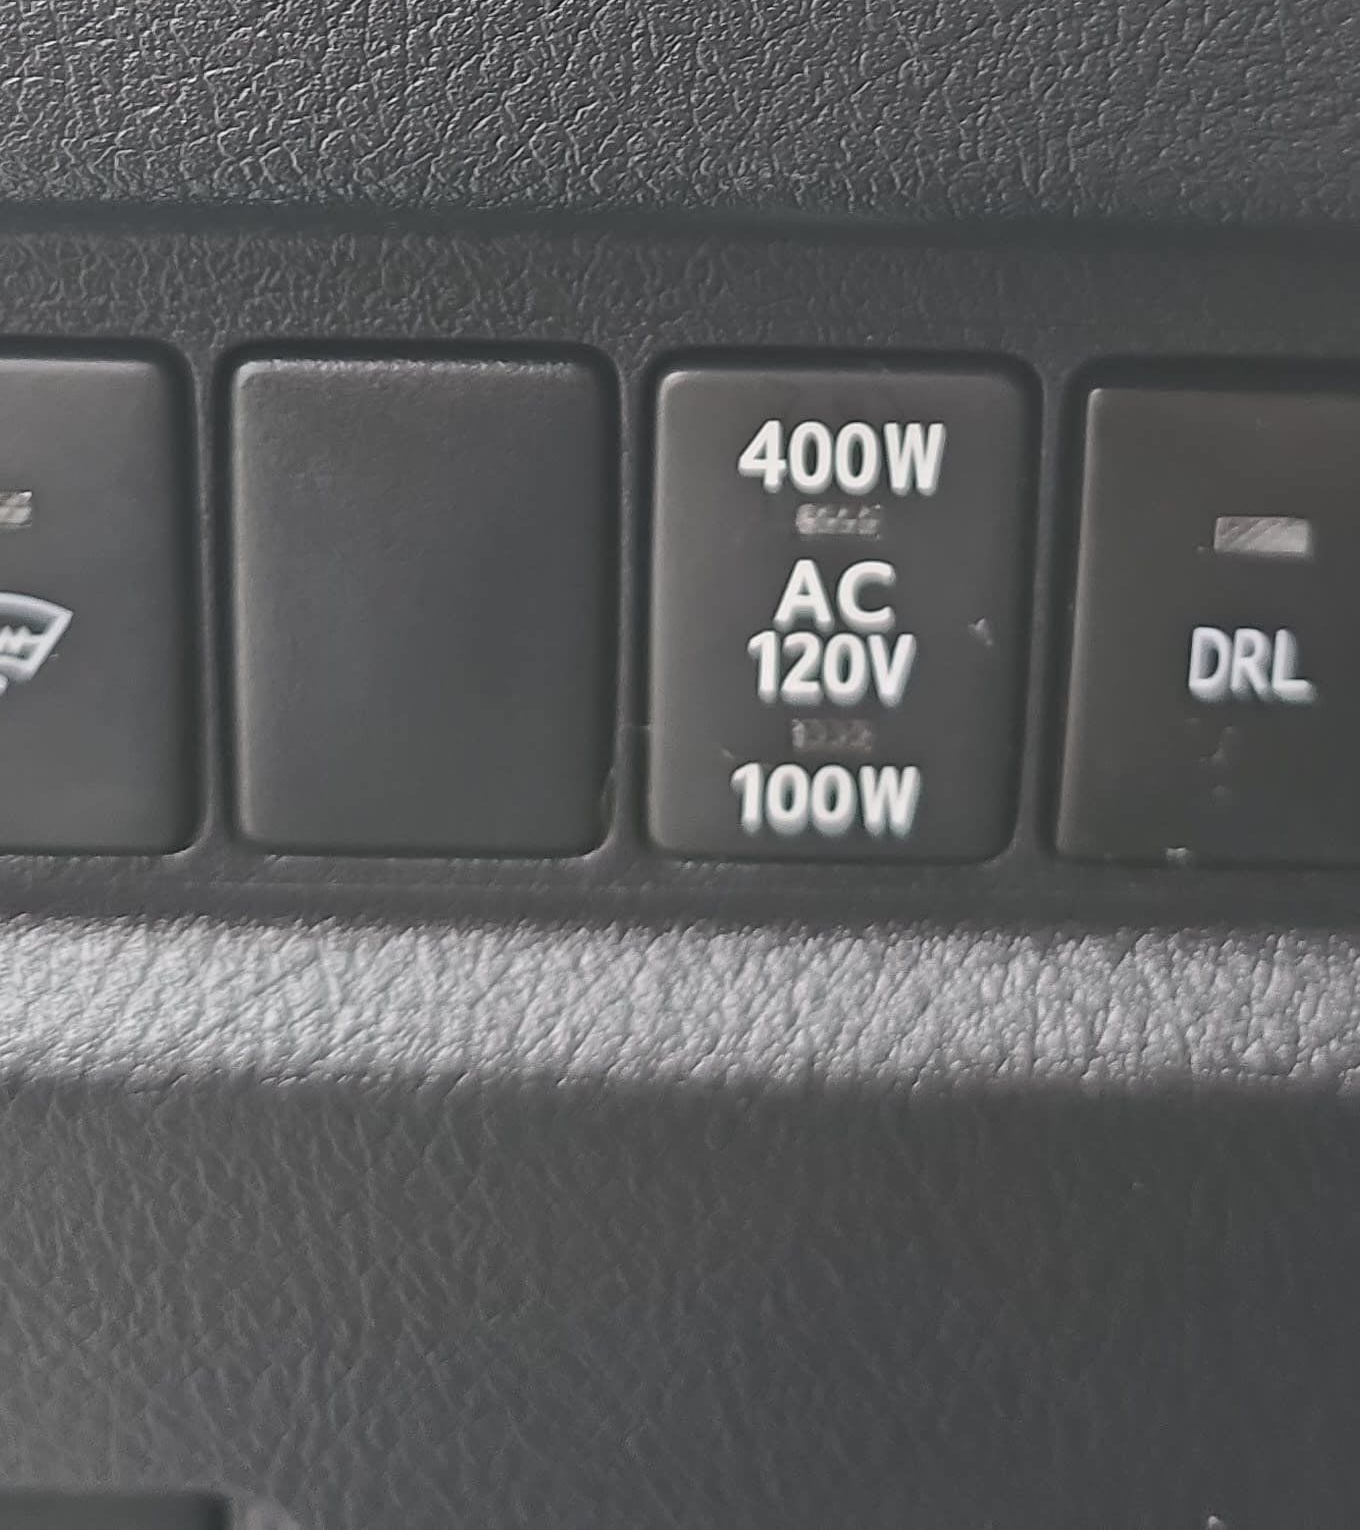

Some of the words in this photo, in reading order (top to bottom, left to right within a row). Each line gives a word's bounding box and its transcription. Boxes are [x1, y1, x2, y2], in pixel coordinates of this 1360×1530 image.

[738, 420, 945, 497] 400W
[773, 559, 898, 633] AC
[747, 630, 917, 707] 120V
[1187, 626, 1318, 703] DRL
[730, 762, 921, 836] 100W
